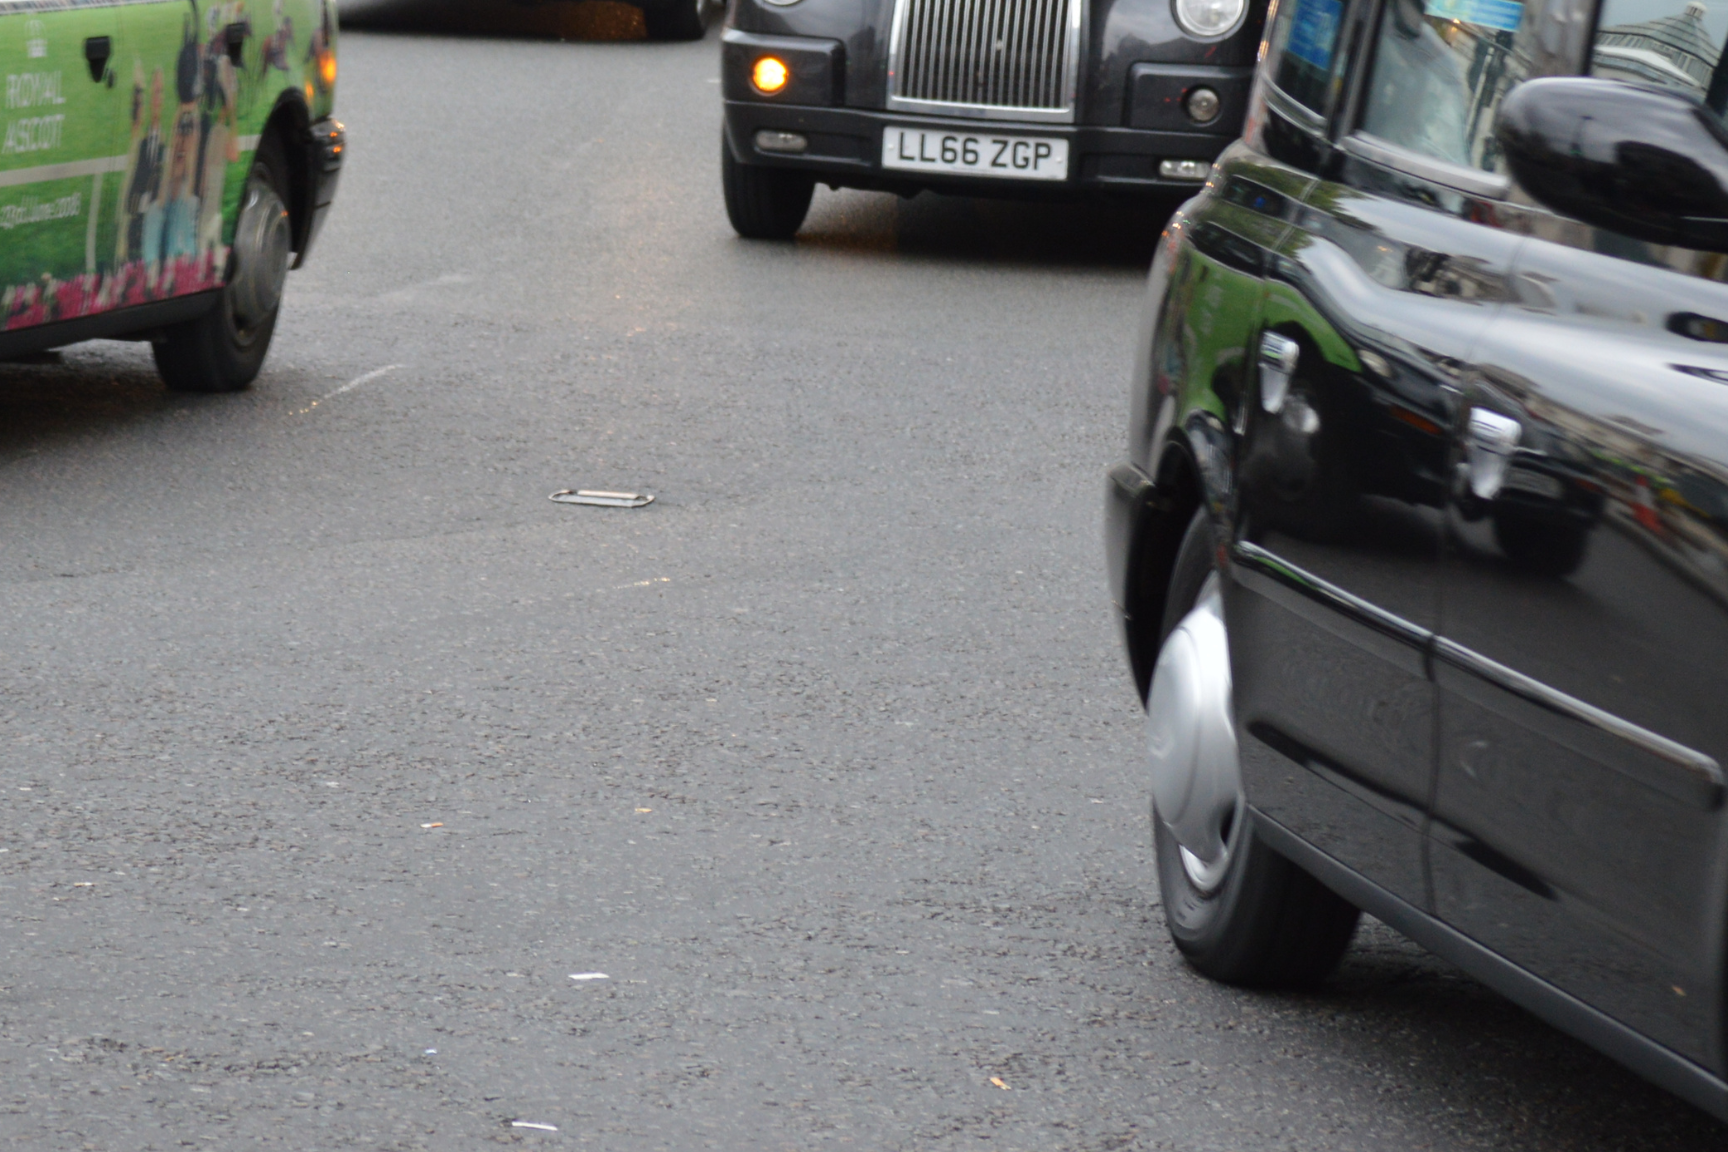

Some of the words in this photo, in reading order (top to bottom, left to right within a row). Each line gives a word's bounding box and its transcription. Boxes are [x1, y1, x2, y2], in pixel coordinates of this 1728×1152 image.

[5, 70, 66, 109] ROYAL
[2, 114, 66, 154] ASCOT
[898, 131, 980, 166] LL66
[990, 138, 1053, 171] ZGP
